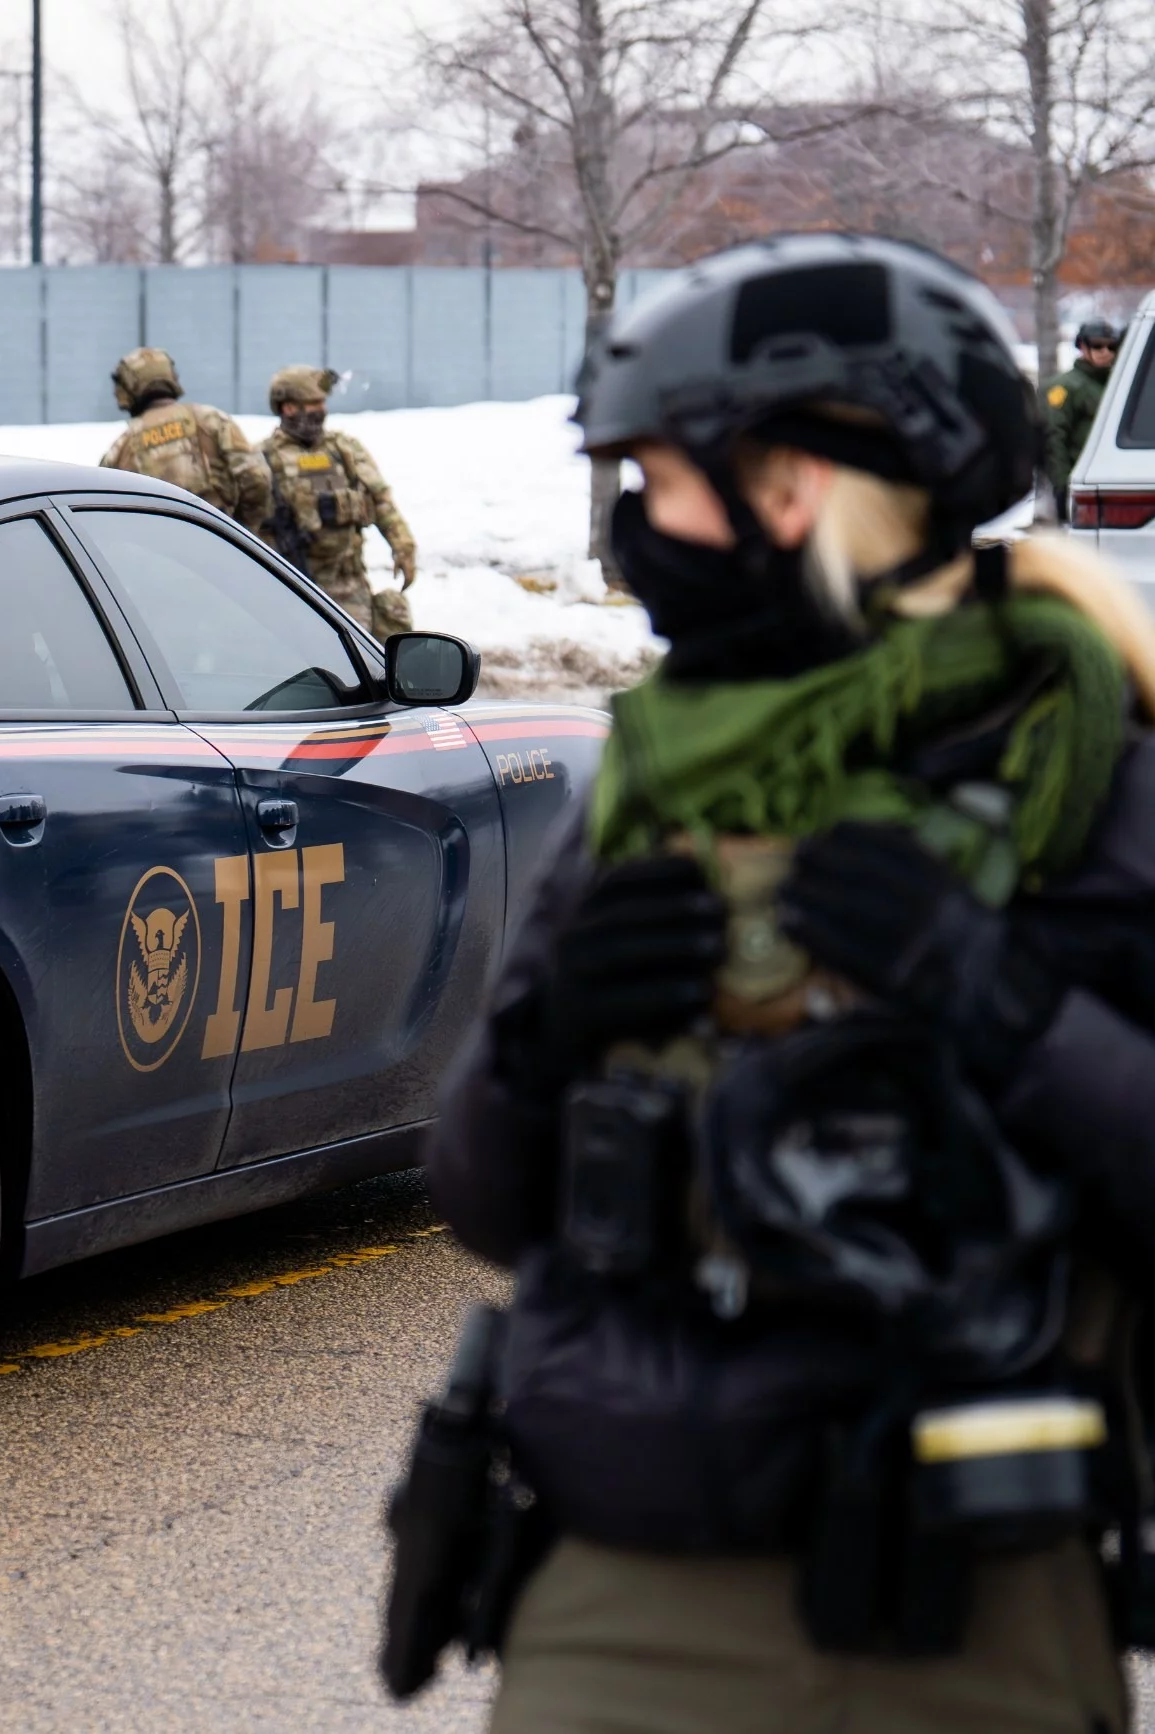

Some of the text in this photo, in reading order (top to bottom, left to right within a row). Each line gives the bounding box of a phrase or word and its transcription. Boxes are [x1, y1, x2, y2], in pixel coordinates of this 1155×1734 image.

[143, 421, 185, 450] POLICE
[496, 748, 556, 786] POLICE
[200, 842, 345, 1060] ICE
